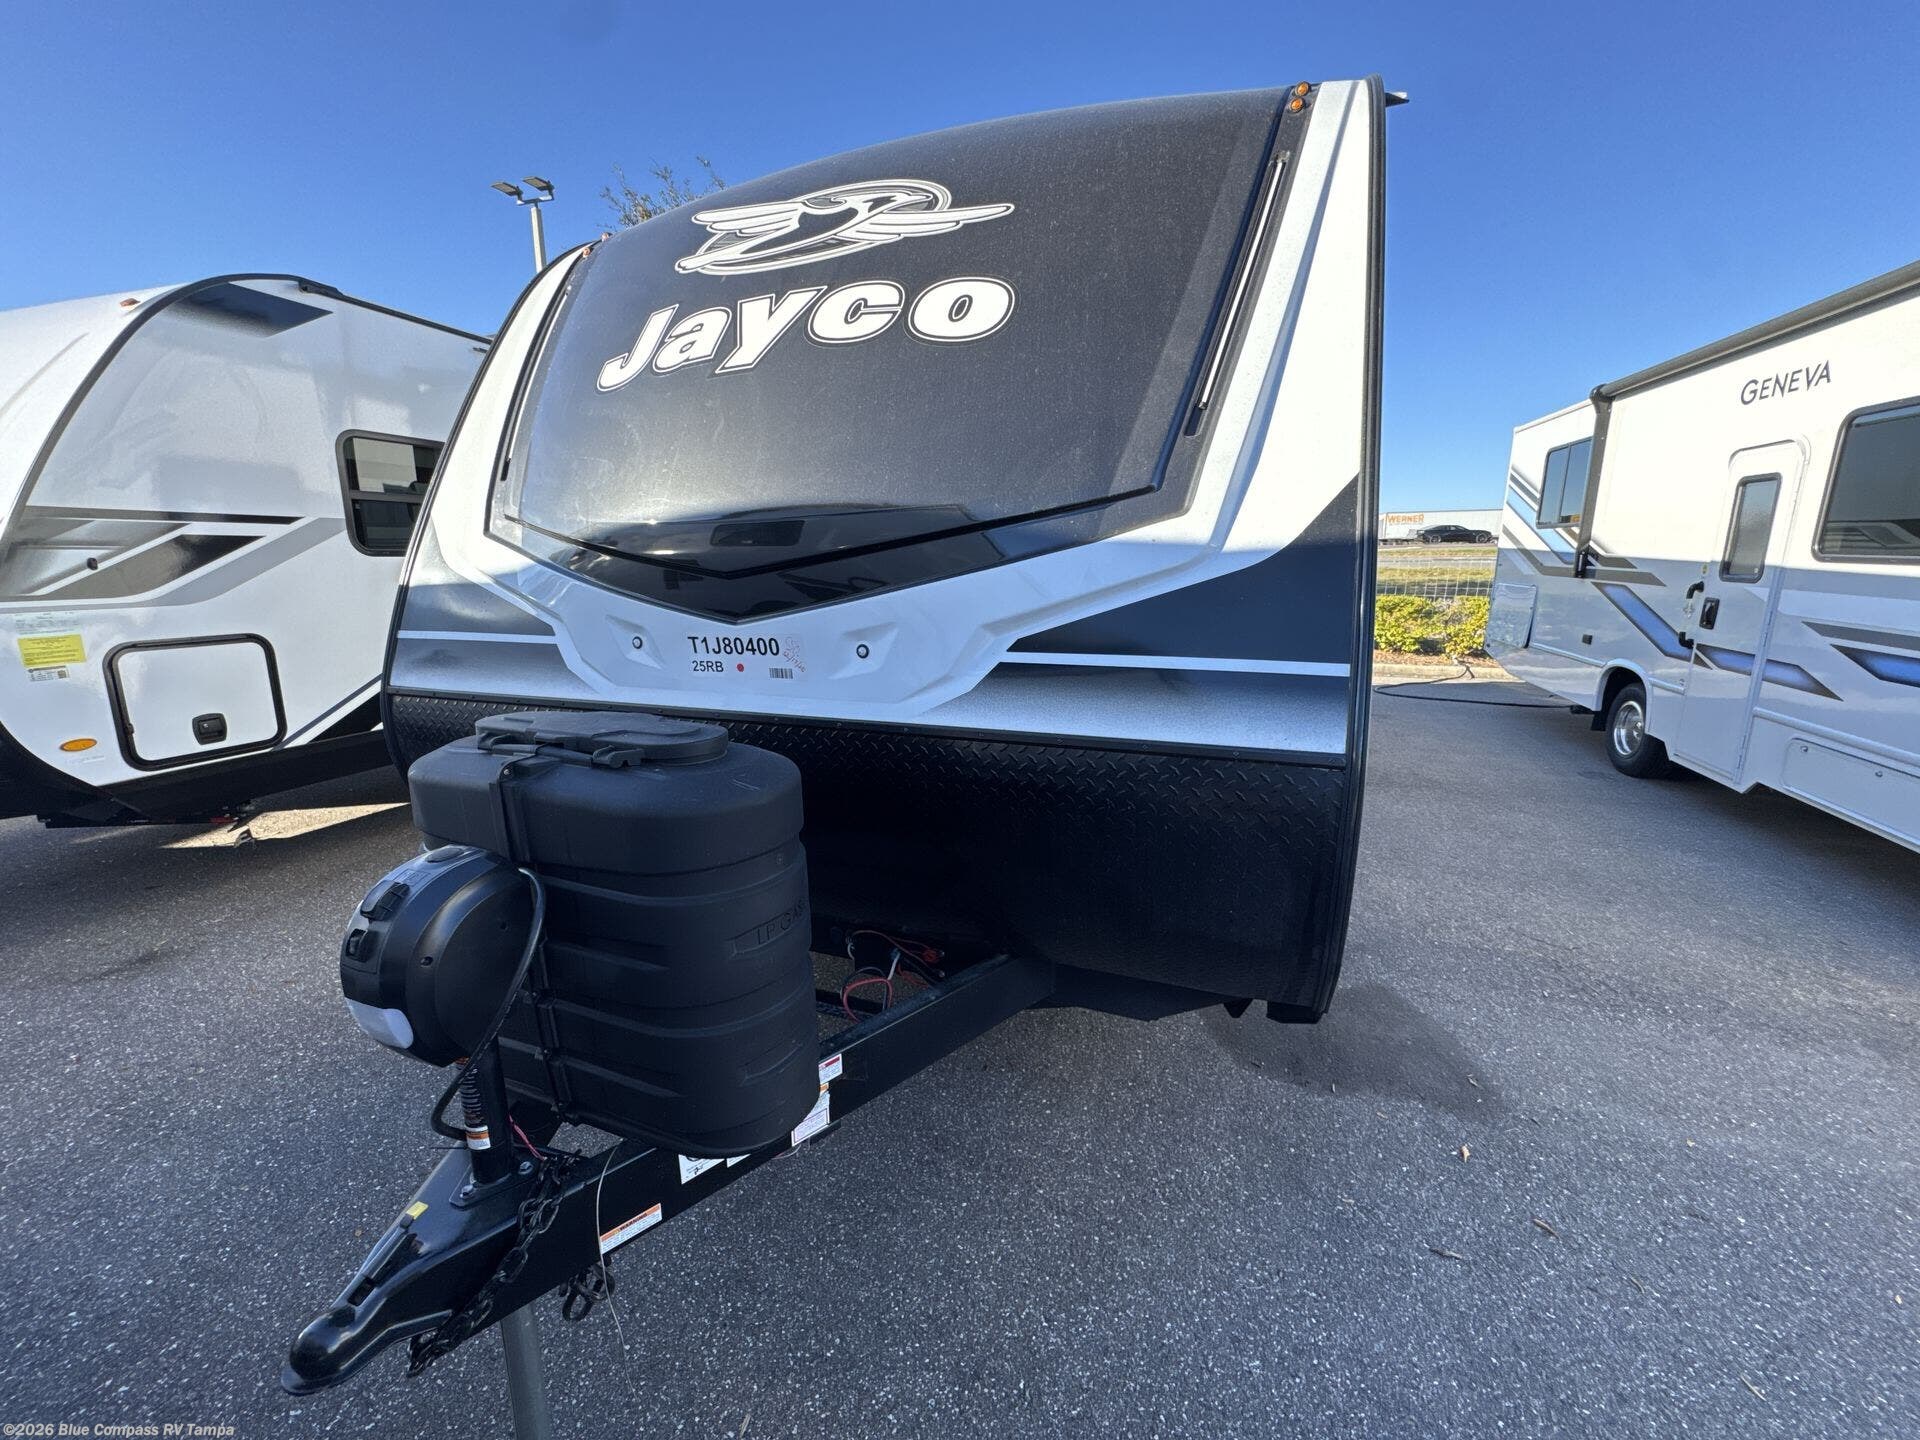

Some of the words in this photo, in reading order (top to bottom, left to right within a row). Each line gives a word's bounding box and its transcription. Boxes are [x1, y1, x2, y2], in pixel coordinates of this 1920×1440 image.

[596, 277, 1016, 393] Jayco
[1740, 360, 1831, 405] GENEVA
[1387, 513, 1425, 524] WERNER
[687, 636, 780, 657] T1J80400
[692, 660, 724, 672] 25RB
